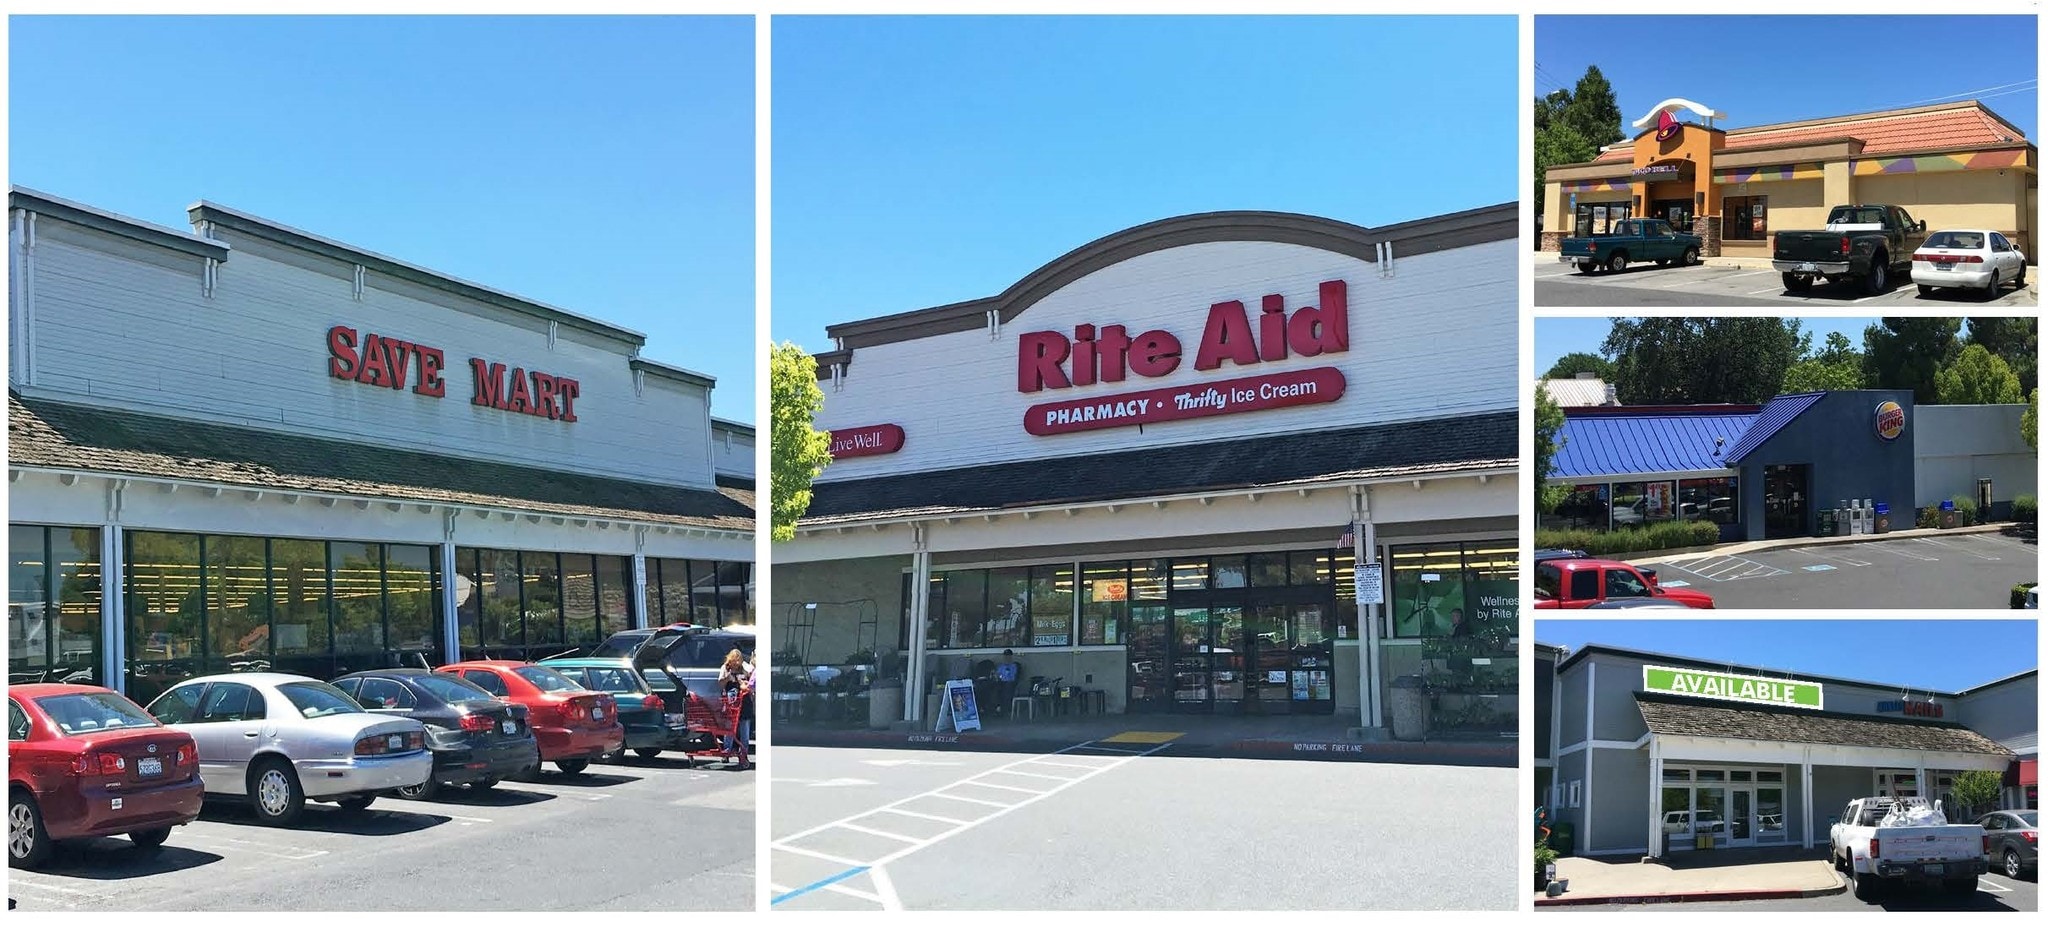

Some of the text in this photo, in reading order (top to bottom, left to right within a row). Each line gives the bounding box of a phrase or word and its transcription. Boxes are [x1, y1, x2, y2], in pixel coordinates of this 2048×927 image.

[1018, 280, 1350, 393] Rite Aid
[327, 325, 580, 423] SAVE MART
[1046, 380, 1317, 426] PHARMACY Thrifty Ice Cream
[1879, 408, 1903, 433] BURGER KING
[1492, 608, 1512, 619] Rite
